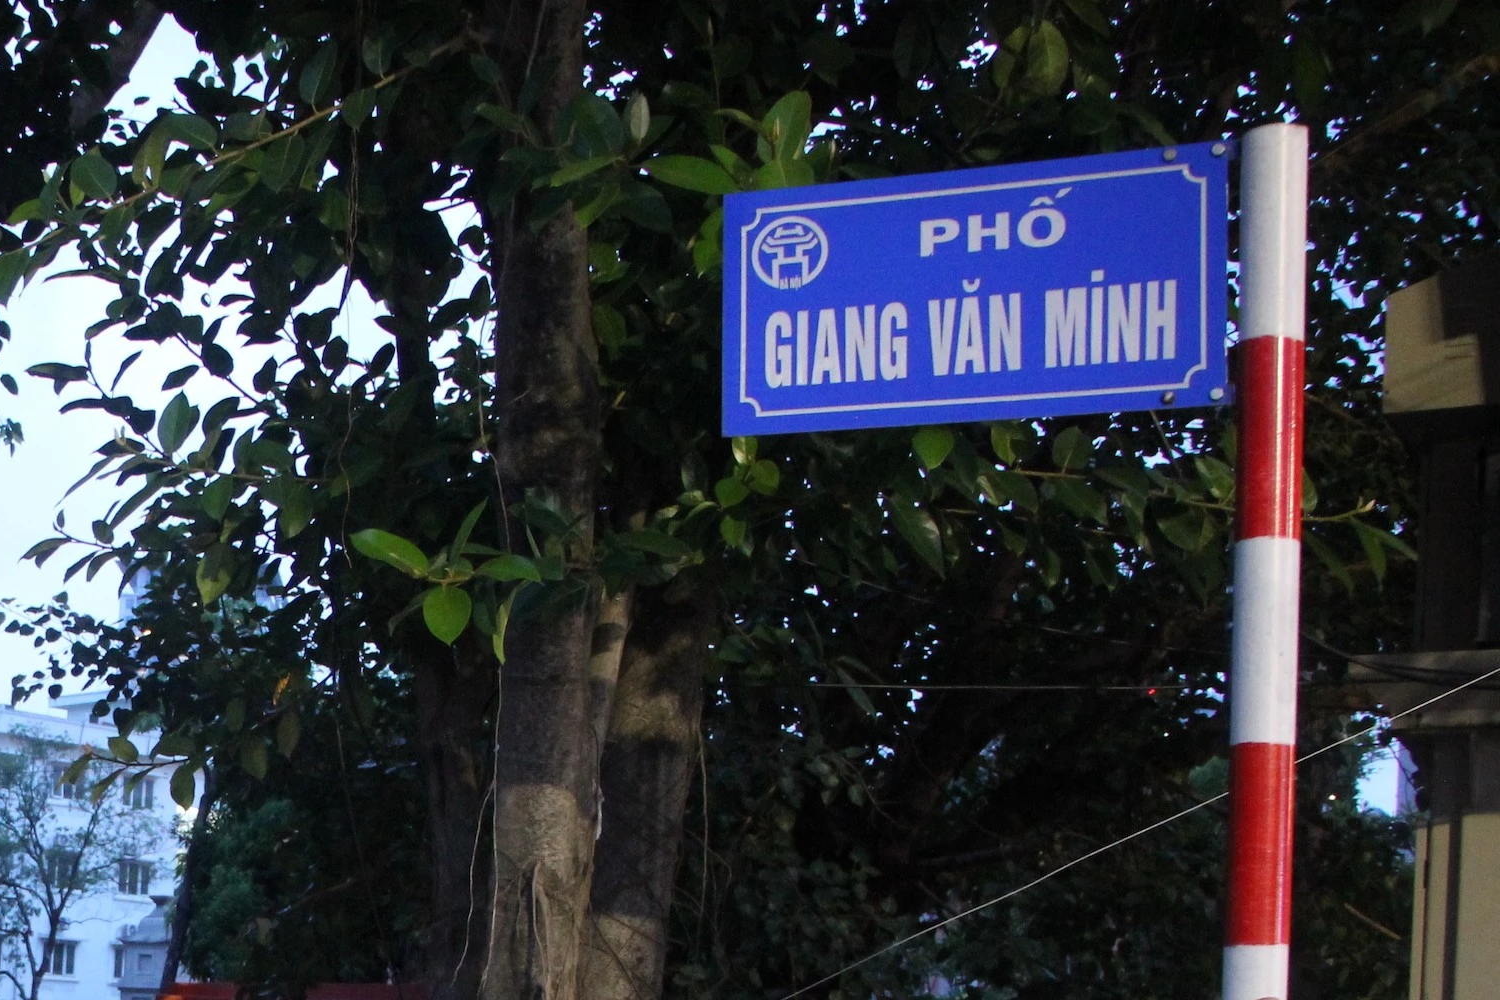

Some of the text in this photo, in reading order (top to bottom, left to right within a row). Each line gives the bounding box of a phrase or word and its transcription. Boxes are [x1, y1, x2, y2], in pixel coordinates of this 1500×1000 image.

[919, 187, 1072, 257] PHỐ
[764, 302, 908, 389] GIANG
[928, 277, 1022, 376] VĂN
